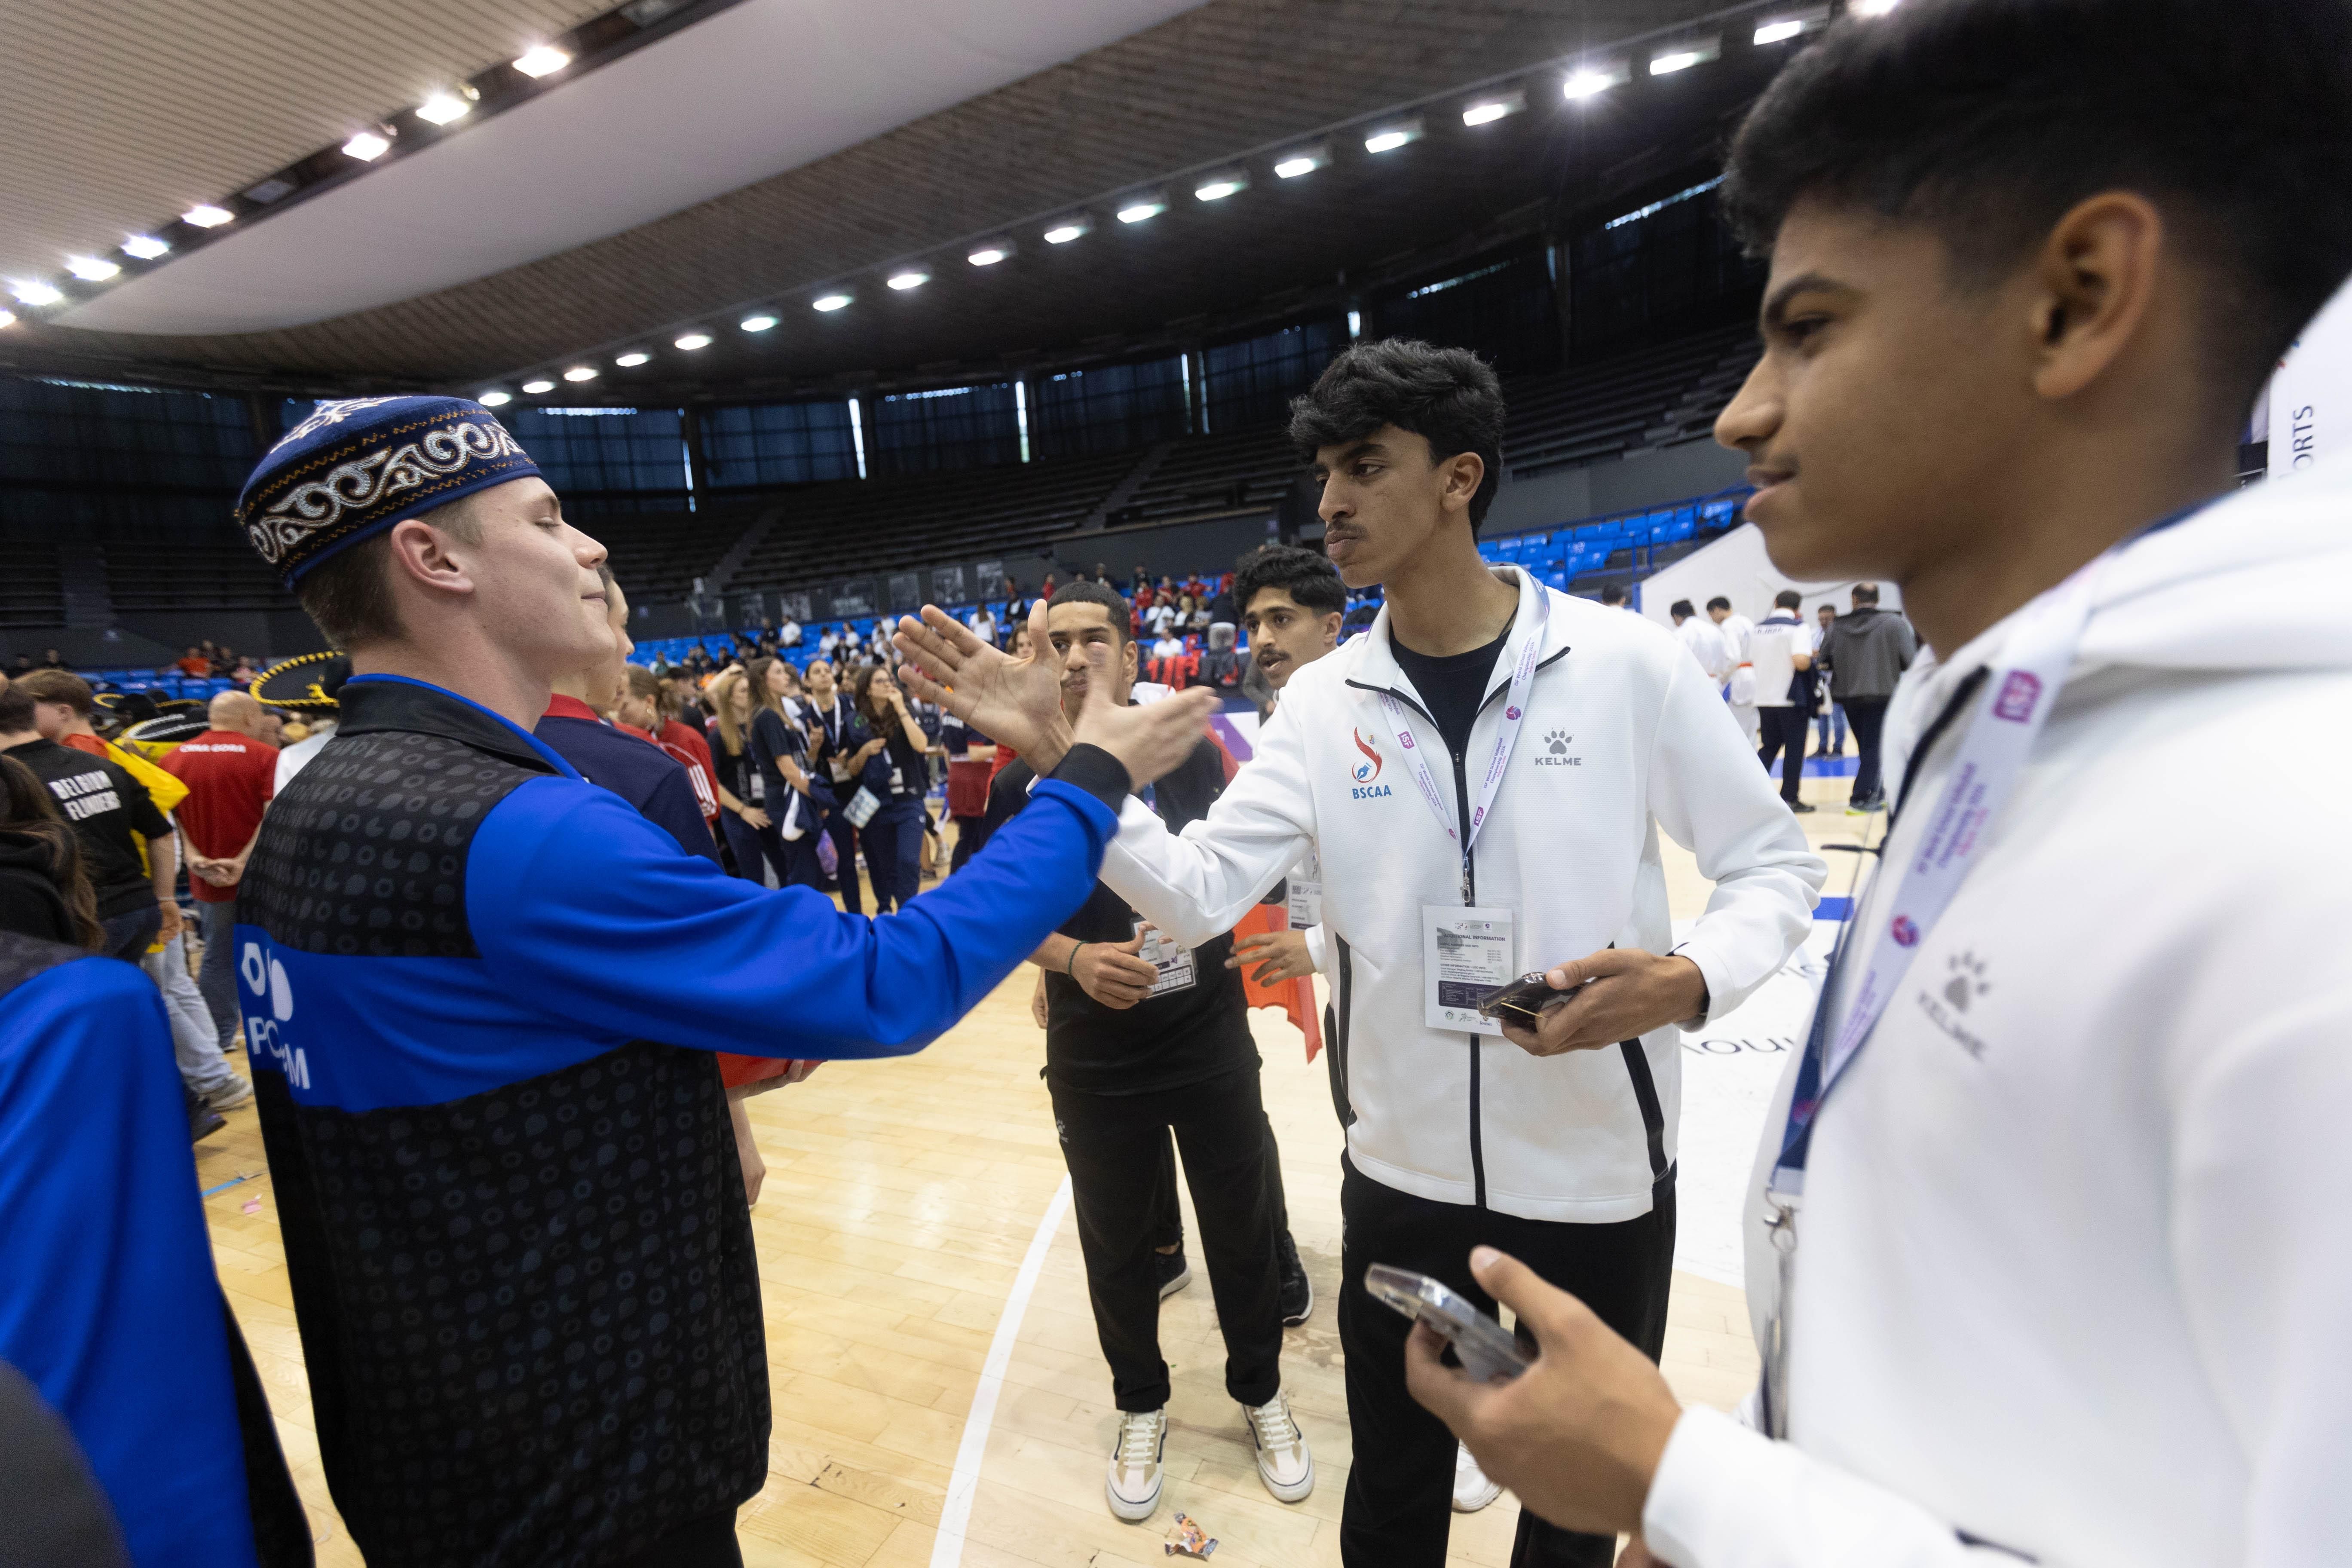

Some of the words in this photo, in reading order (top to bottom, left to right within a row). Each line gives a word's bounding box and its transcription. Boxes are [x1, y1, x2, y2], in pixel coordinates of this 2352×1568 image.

[2293, 405, 2313, 469] ORTS
[1522, 652, 1532, 680] Championship
[1400, 733, 1412, 747] ISF
[1490, 756, 1502, 784] Championship
[1535, 757, 1581, 766] KELME
[1352, 785, 1392, 799] BSCAA
[1475, 808, 1483, 825] ISF
